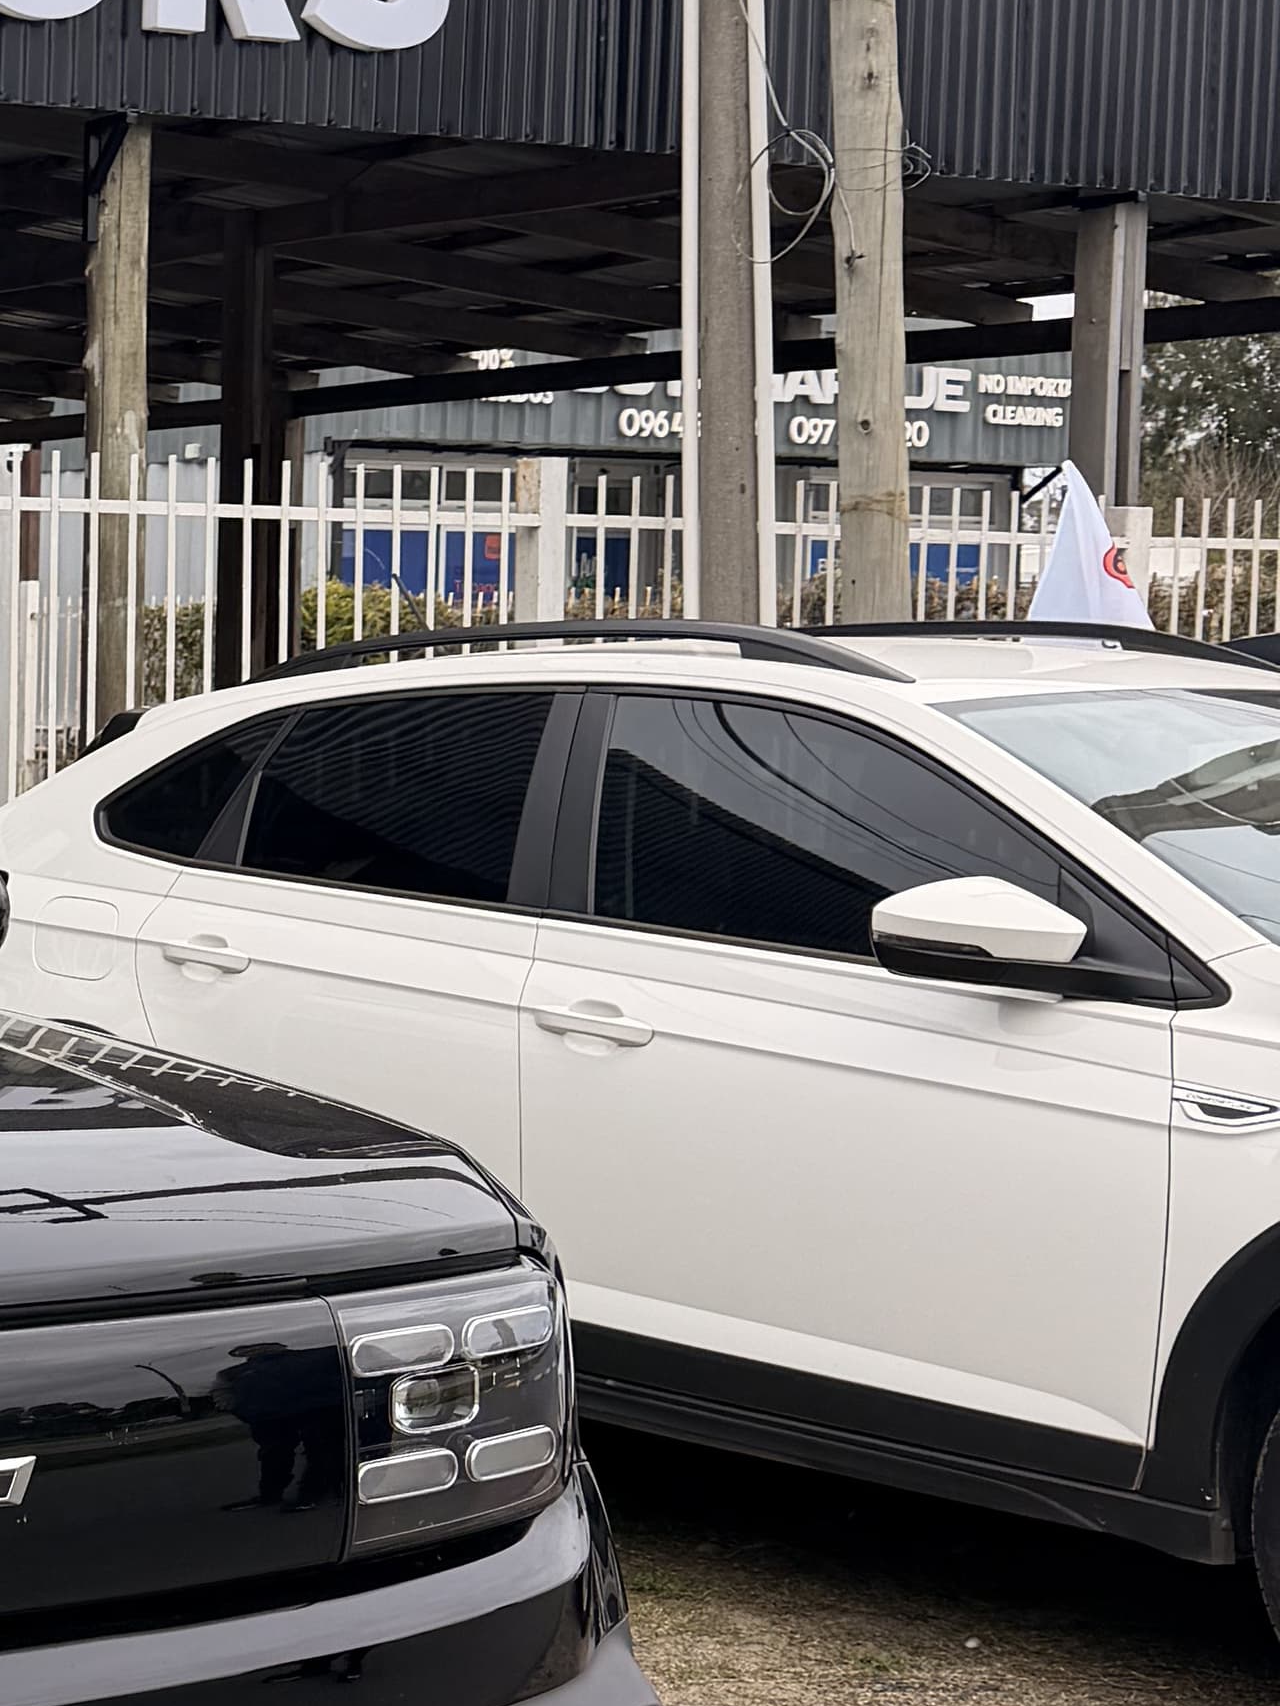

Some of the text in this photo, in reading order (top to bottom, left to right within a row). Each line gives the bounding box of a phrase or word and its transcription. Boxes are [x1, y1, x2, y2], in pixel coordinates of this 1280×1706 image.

[469, 349, 515, 371] 00%
[978, 373, 1005, 394] NO
[985, 403, 1063, 427] CLEARING
